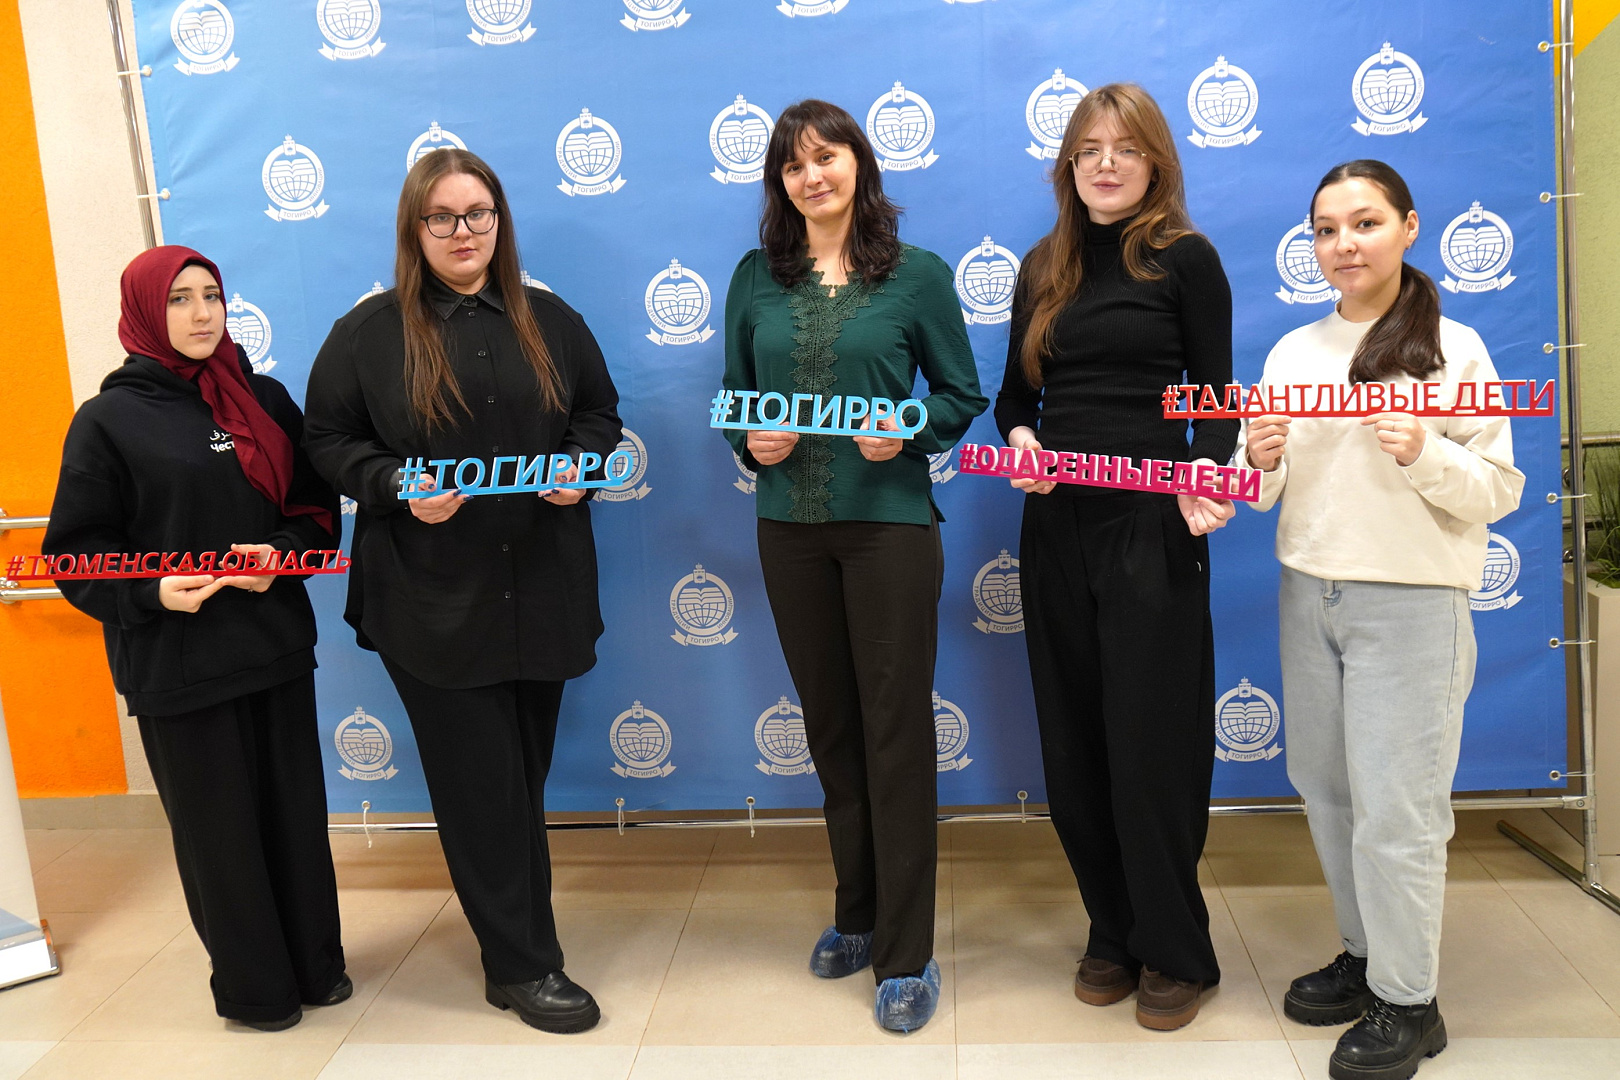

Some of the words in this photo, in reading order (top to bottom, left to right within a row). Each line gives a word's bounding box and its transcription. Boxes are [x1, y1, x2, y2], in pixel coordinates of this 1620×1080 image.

[640, 18, 671, 28] ТОГИРРО
[487, 32, 518, 42] ТОГИРРО
[1373, 123, 1406, 132] ТОГИРРО
[1209, 135, 1241, 145] ТОГИРРО
[887, 159, 919, 169] ТОГИРРО
[730, 172, 762, 182] ТОГИРРО
[577, 184, 608, 194] ТОГИРРО
[283, 209, 313, 219] ТОГИРРО
[1461, 280, 1495, 290] ТОГИРРО
[1296, 291, 1329, 301] ТОГИРРО
[976, 313, 1008, 322] ТОГИРРО
[665, 334, 697, 343] ТОГИРРО
[1161, 381, 1441, 415] #ТАЛАНТЛИВЫЕ
[1454, 379, 1556, 415] ДЕТИ
[710, 389, 928, 436] #ТОГИРРО
[397, 450, 635, 498] #ТОГИРРО
[959, 443, 1264, 502] #ОДАРЕННЫЕДЕТИ
[603, 491, 633, 500] ТОГИРРО
[5, 551, 214, 580] #ТЮМЕНСКАЯ
[221, 549, 353, 576] ОБЛАСТЬ
[974, 585, 994, 618] ТРАДИЦИИ
[671, 599, 691, 631] ТРАДИЦИИ
[992, 623, 1024, 632] ТОГИРРО
[690, 636, 720, 645] ТОГИРРО
[611, 733, 630, 764] ТРАДИЦИИ
[756, 730, 775, 760] ТРАДИЦИИ
[1231, 751, 1263, 760] ТОГИРРО
[774, 766, 804, 774] ТОГИРРО
[936, 762, 954, 770] ИРРО
[354, 771, 382, 780] ТОГИРРО
[629, 768, 659, 777] ТОГИРРО
